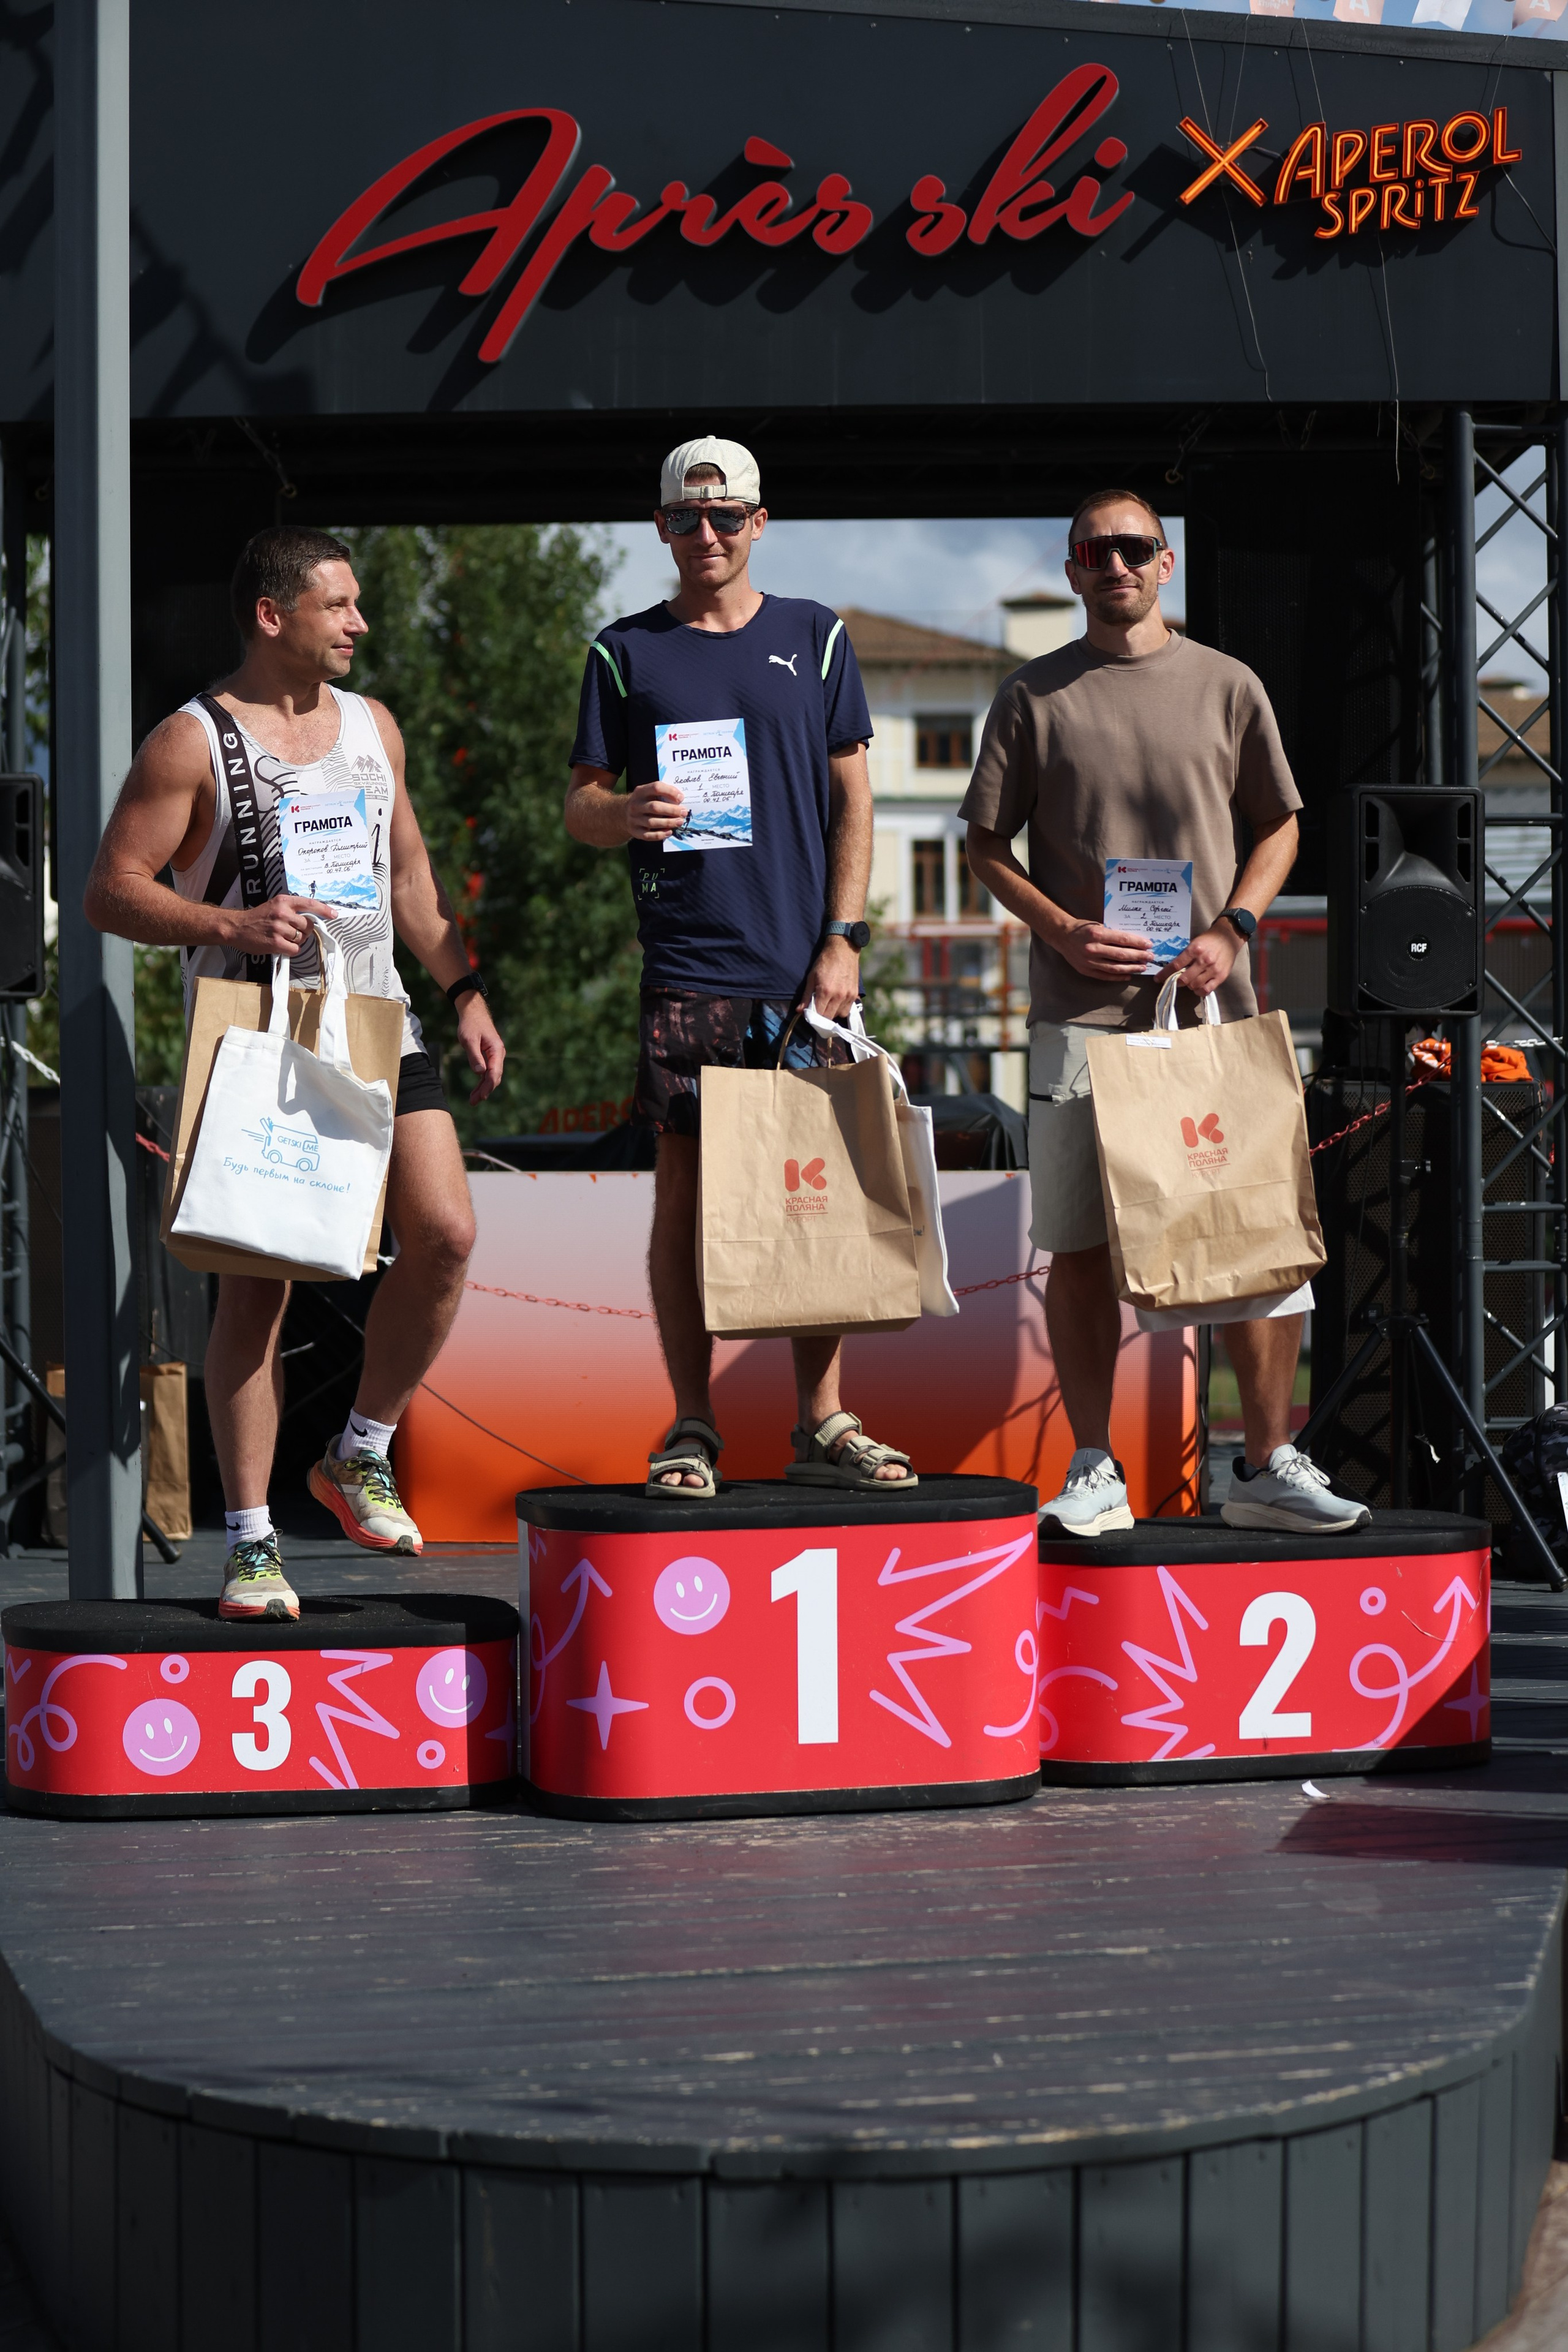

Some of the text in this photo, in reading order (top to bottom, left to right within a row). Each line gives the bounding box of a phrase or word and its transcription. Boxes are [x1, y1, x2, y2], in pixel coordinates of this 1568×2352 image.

[1273, 107, 1523, 206] APEROL
[296, 62, 1135, 363] Après ski
[673, 746, 732, 761] ГРАМОТА
[352, 774, 386, 782] SOCHI
[295, 816, 353, 833] ГРАМОТА
[1119, 881, 1177, 892] ГРАМОТА
[1411, 943, 1427, 952] RCF
[1187, 1147, 1228, 1161] КРАСНАЯ
[223, 1157, 248, 1175] Будь
[254, 1167, 289, 1180] первым
[1189, 1156, 1227, 1167] ПОЛЯНА
[1191, 1168, 1220, 1178] КУРОРТ
[785, 1196, 828, 1205] КРАСНАЯ
[786, 1204, 825, 1212] ПОЛЯНА
[771, 1548, 839, 1744] 1
[1239, 1591, 1316, 1740] 2
[231, 1660, 292, 1771] 3
